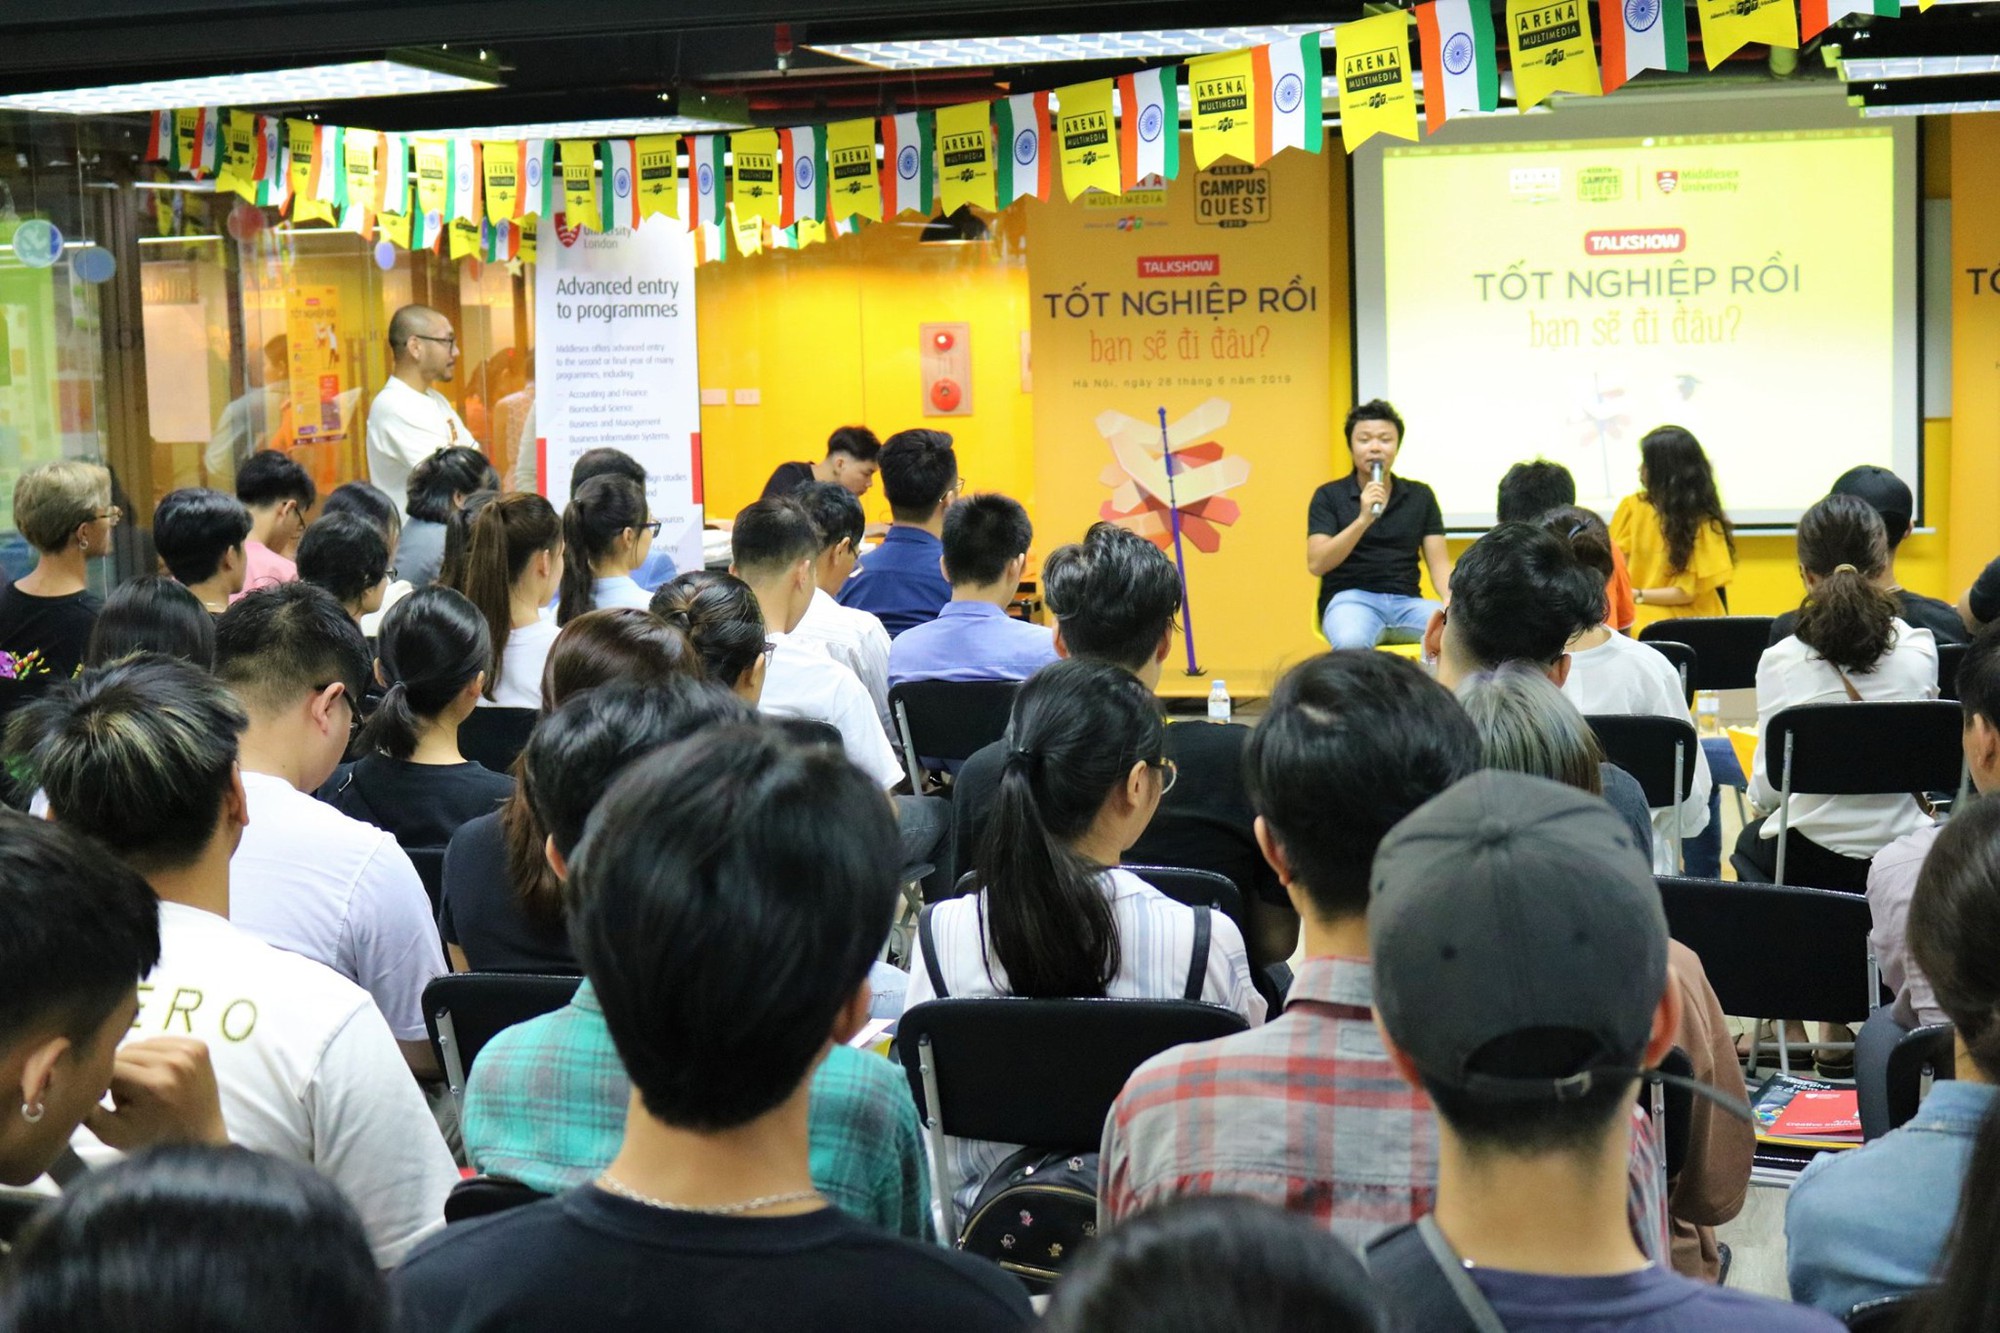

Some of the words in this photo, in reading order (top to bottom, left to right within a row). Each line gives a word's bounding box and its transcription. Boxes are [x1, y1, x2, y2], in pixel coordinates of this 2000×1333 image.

[1520, 5, 1575, 31] ARENA
[1522, 25, 1577, 47] MULTIMEDIA
[1347, 52, 1397, 74] ARENA
[1199, 80, 1244, 98] ARENA
[1348, 71, 1399, 89] MULTIMEDIA
[1200, 98, 1245, 111] MULTIMEDIA
[1065, 115, 1105, 133] ARENA
[944, 135, 983, 150] ARENA
[1067, 132, 1107, 146] MULTIMEDIA
[740, 156, 771, 168] ARENA
[834, 149, 869, 164] ARENA
[1201, 178, 1267, 197] CAMPUS
[1089, 193, 1163, 206] MULTIMEDIA
[1201, 196, 1267, 217] QUEST
[583, 238, 618, 249] London
[1590, 234, 1681, 250] TALKSHOW
[1143, 260, 1214, 273] TALKSHOW
[1473, 259, 1553, 301] TỐT
[1567, 259, 1717, 304] NGHIỆP
[1731, 251, 1800, 295] RỒI
[556, 276, 632, 295] Advanced
[638, 278, 679, 299] entry
[1043, 282, 1110, 318] TỐT
[1122, 282, 1248, 321] NGHIỆP
[1259, 275, 1317, 313] RỒI
[556, 302, 572, 319] to
[577, 303, 678, 323] programmes
[1529, 309, 1579, 350] bạn
[1592, 310, 1621, 346] sẽ
[1633, 306, 1659, 345] đi
[1672, 304, 1742, 345] đâu?
[1089, 329, 1133, 366] bạn
[1143, 329, 1167, 360] sẽ
[1177, 328, 1200, 360] đi
[1211, 325, 1271, 360] đâu?
